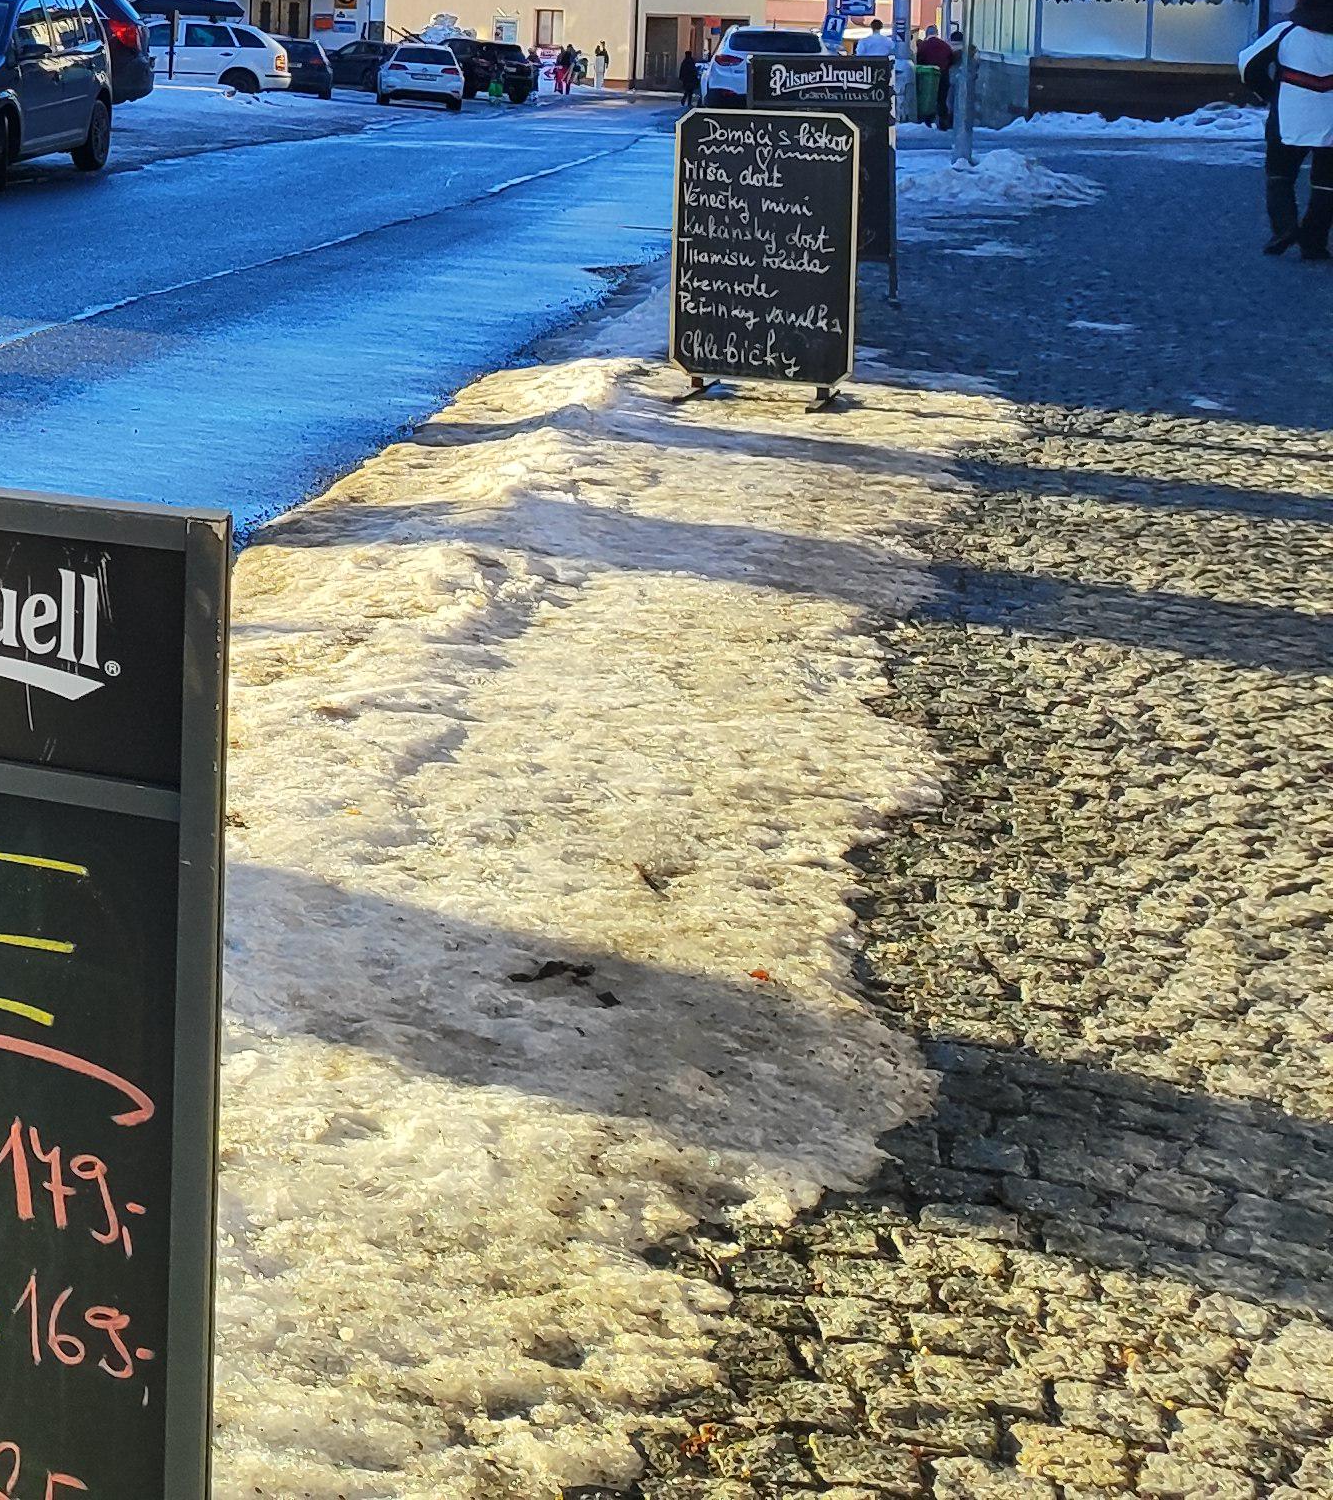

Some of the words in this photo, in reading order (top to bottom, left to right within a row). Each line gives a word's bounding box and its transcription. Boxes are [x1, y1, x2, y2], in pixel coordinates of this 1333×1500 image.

[769, 63, 824, 96] Pilsner
[819, 62, 872, 91] Urquell
[777, 129, 792, 146] s
